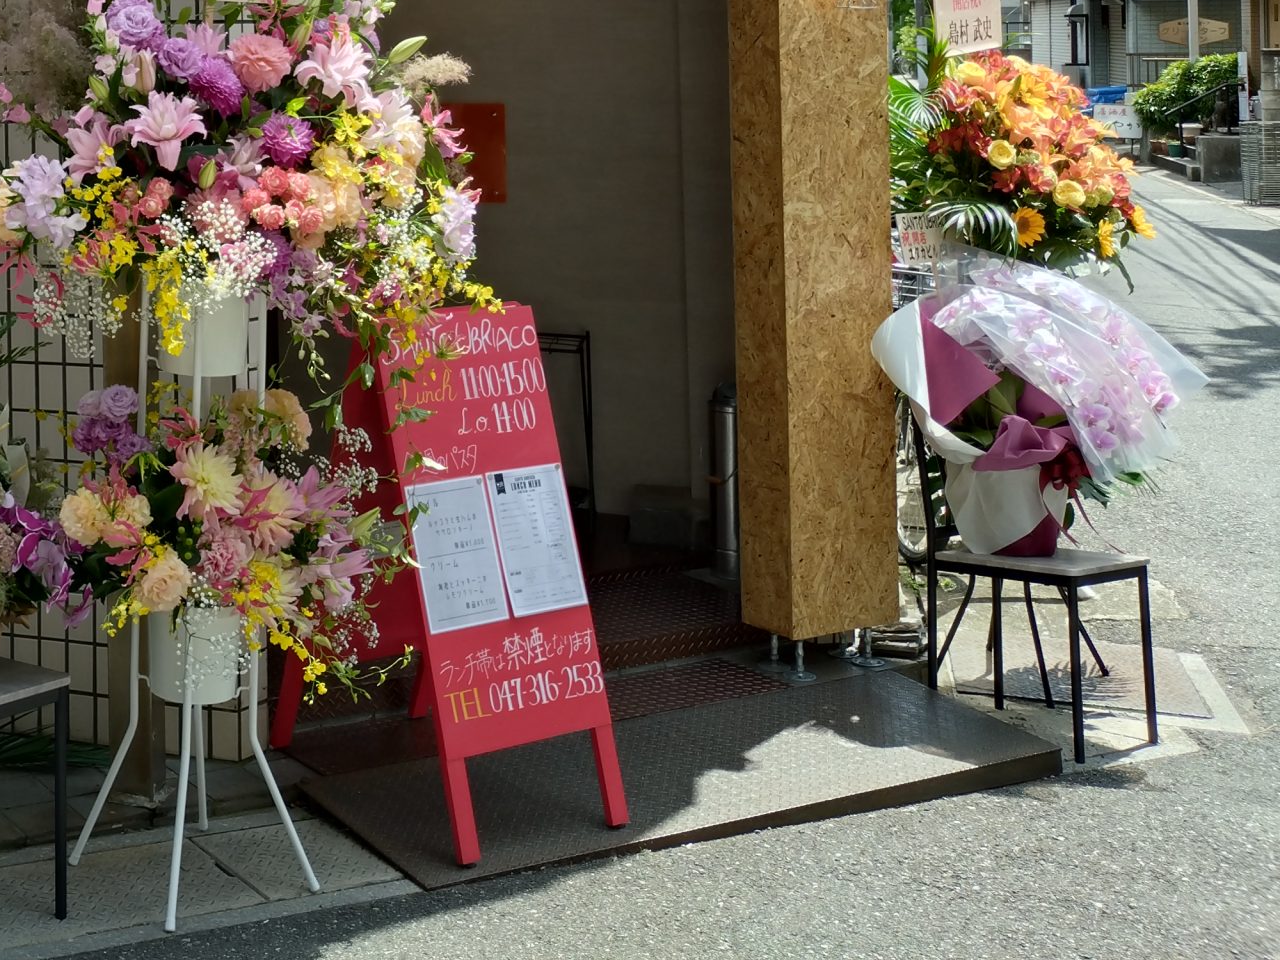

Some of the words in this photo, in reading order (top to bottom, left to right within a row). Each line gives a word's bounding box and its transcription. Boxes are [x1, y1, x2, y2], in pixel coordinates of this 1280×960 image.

[973, 15, 993, 42] 武史
[454, 318, 537, 355] UBRIACO
[395, 369, 457, 410] Lunch
[491, 397, 536, 434] 14:00
[439, 626, 593, 688] ランチ帯は禁煙となります
[443, 687, 493, 724] TEL
[488, 660, 605, 713] 047-316-2533
